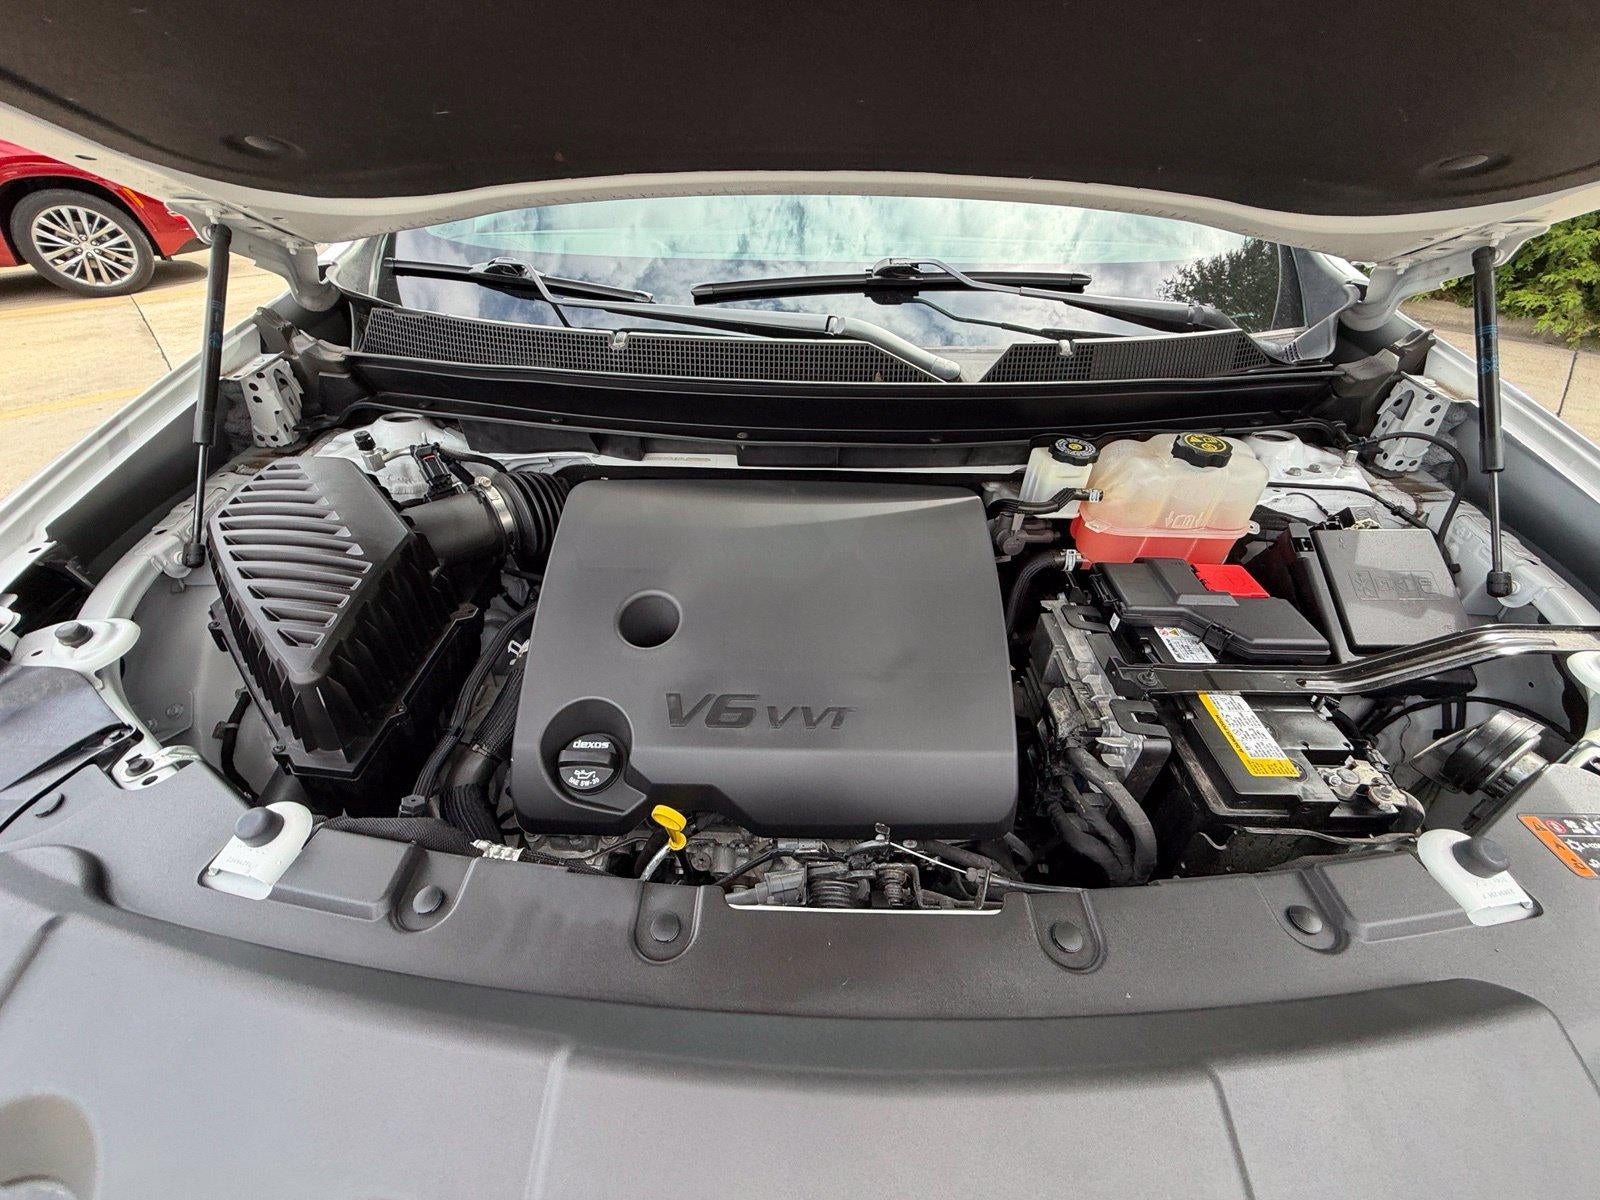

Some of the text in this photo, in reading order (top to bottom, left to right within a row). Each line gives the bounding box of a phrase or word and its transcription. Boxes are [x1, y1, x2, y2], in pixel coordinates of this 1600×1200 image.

[665, 693, 858, 730] V6 VVT
[572, 739, 611, 749] dexos
[568, 776, 580, 786] SAE
